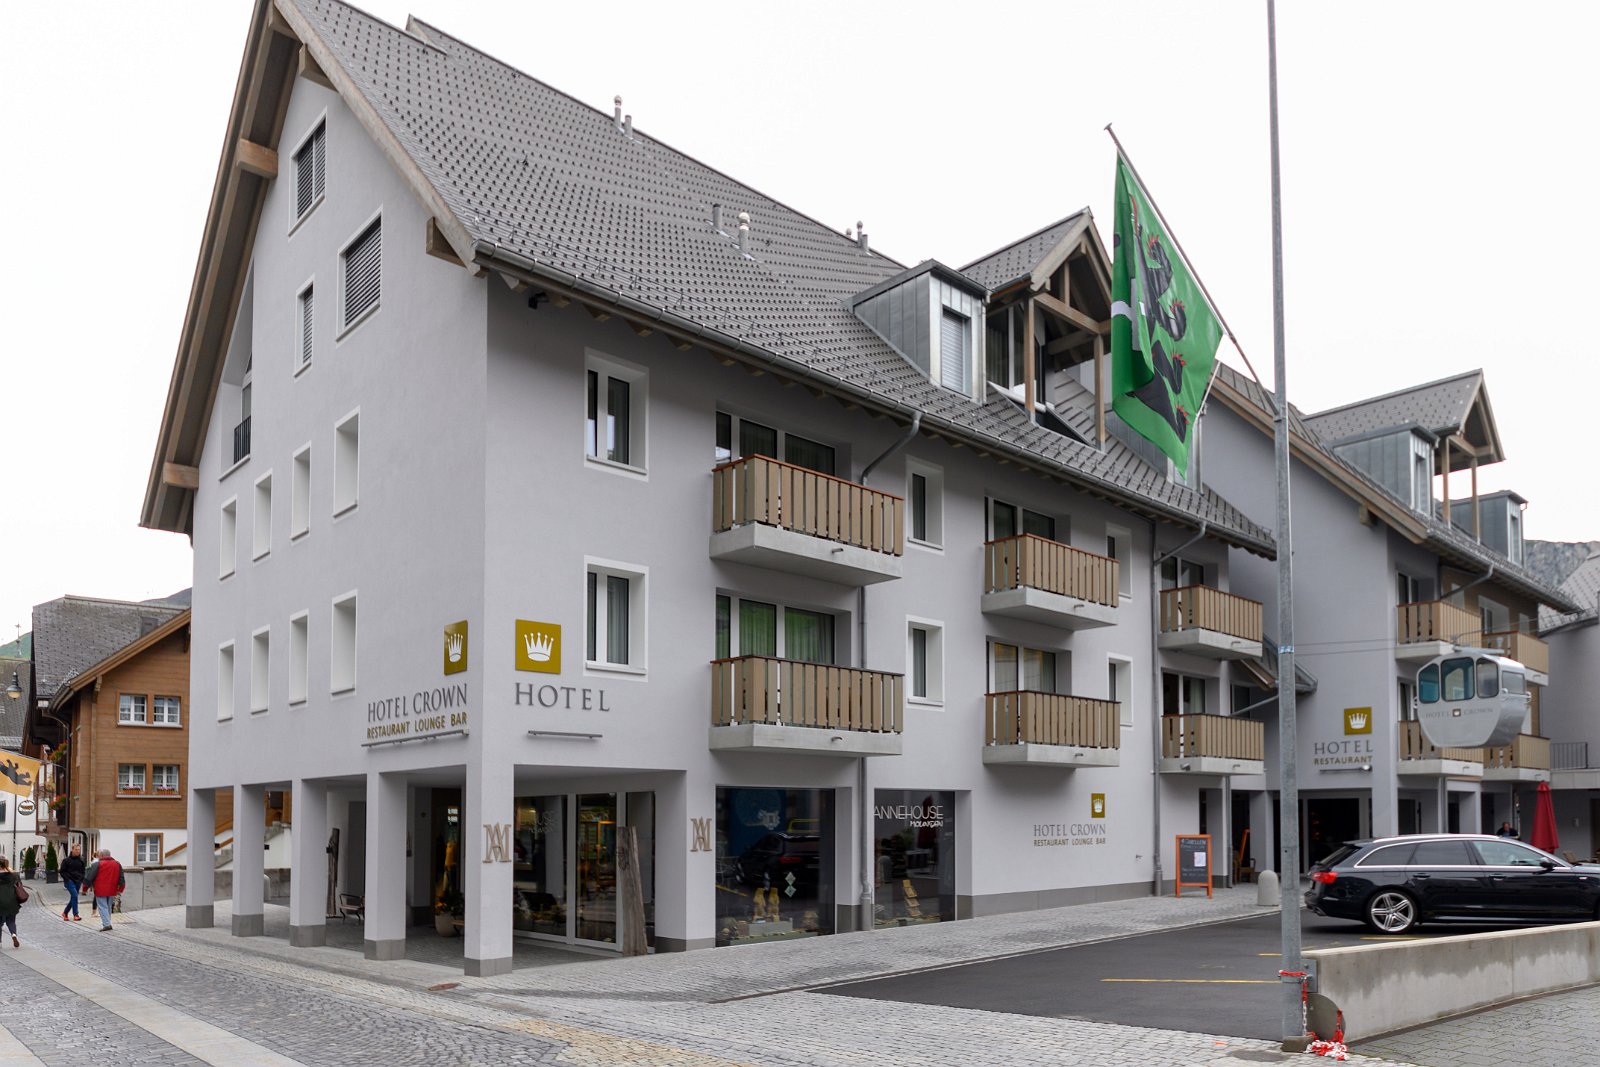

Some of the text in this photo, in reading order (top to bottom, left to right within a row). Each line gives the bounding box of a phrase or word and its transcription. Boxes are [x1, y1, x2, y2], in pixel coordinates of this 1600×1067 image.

[367, 683, 468, 723] HOTEL CROWN
[514, 682, 611, 712] HOTEL
[366, 711, 468, 740] RESTAURANT LOUNGE BAR
[1313, 739, 1373, 755] HOTEL
[1313, 755, 1373, 765] RESTAURANT
[1033, 823, 1106, 837] HOTEL CROWN
[1033, 837, 1106, 847] RESTAURANT LOUNGE BAR
